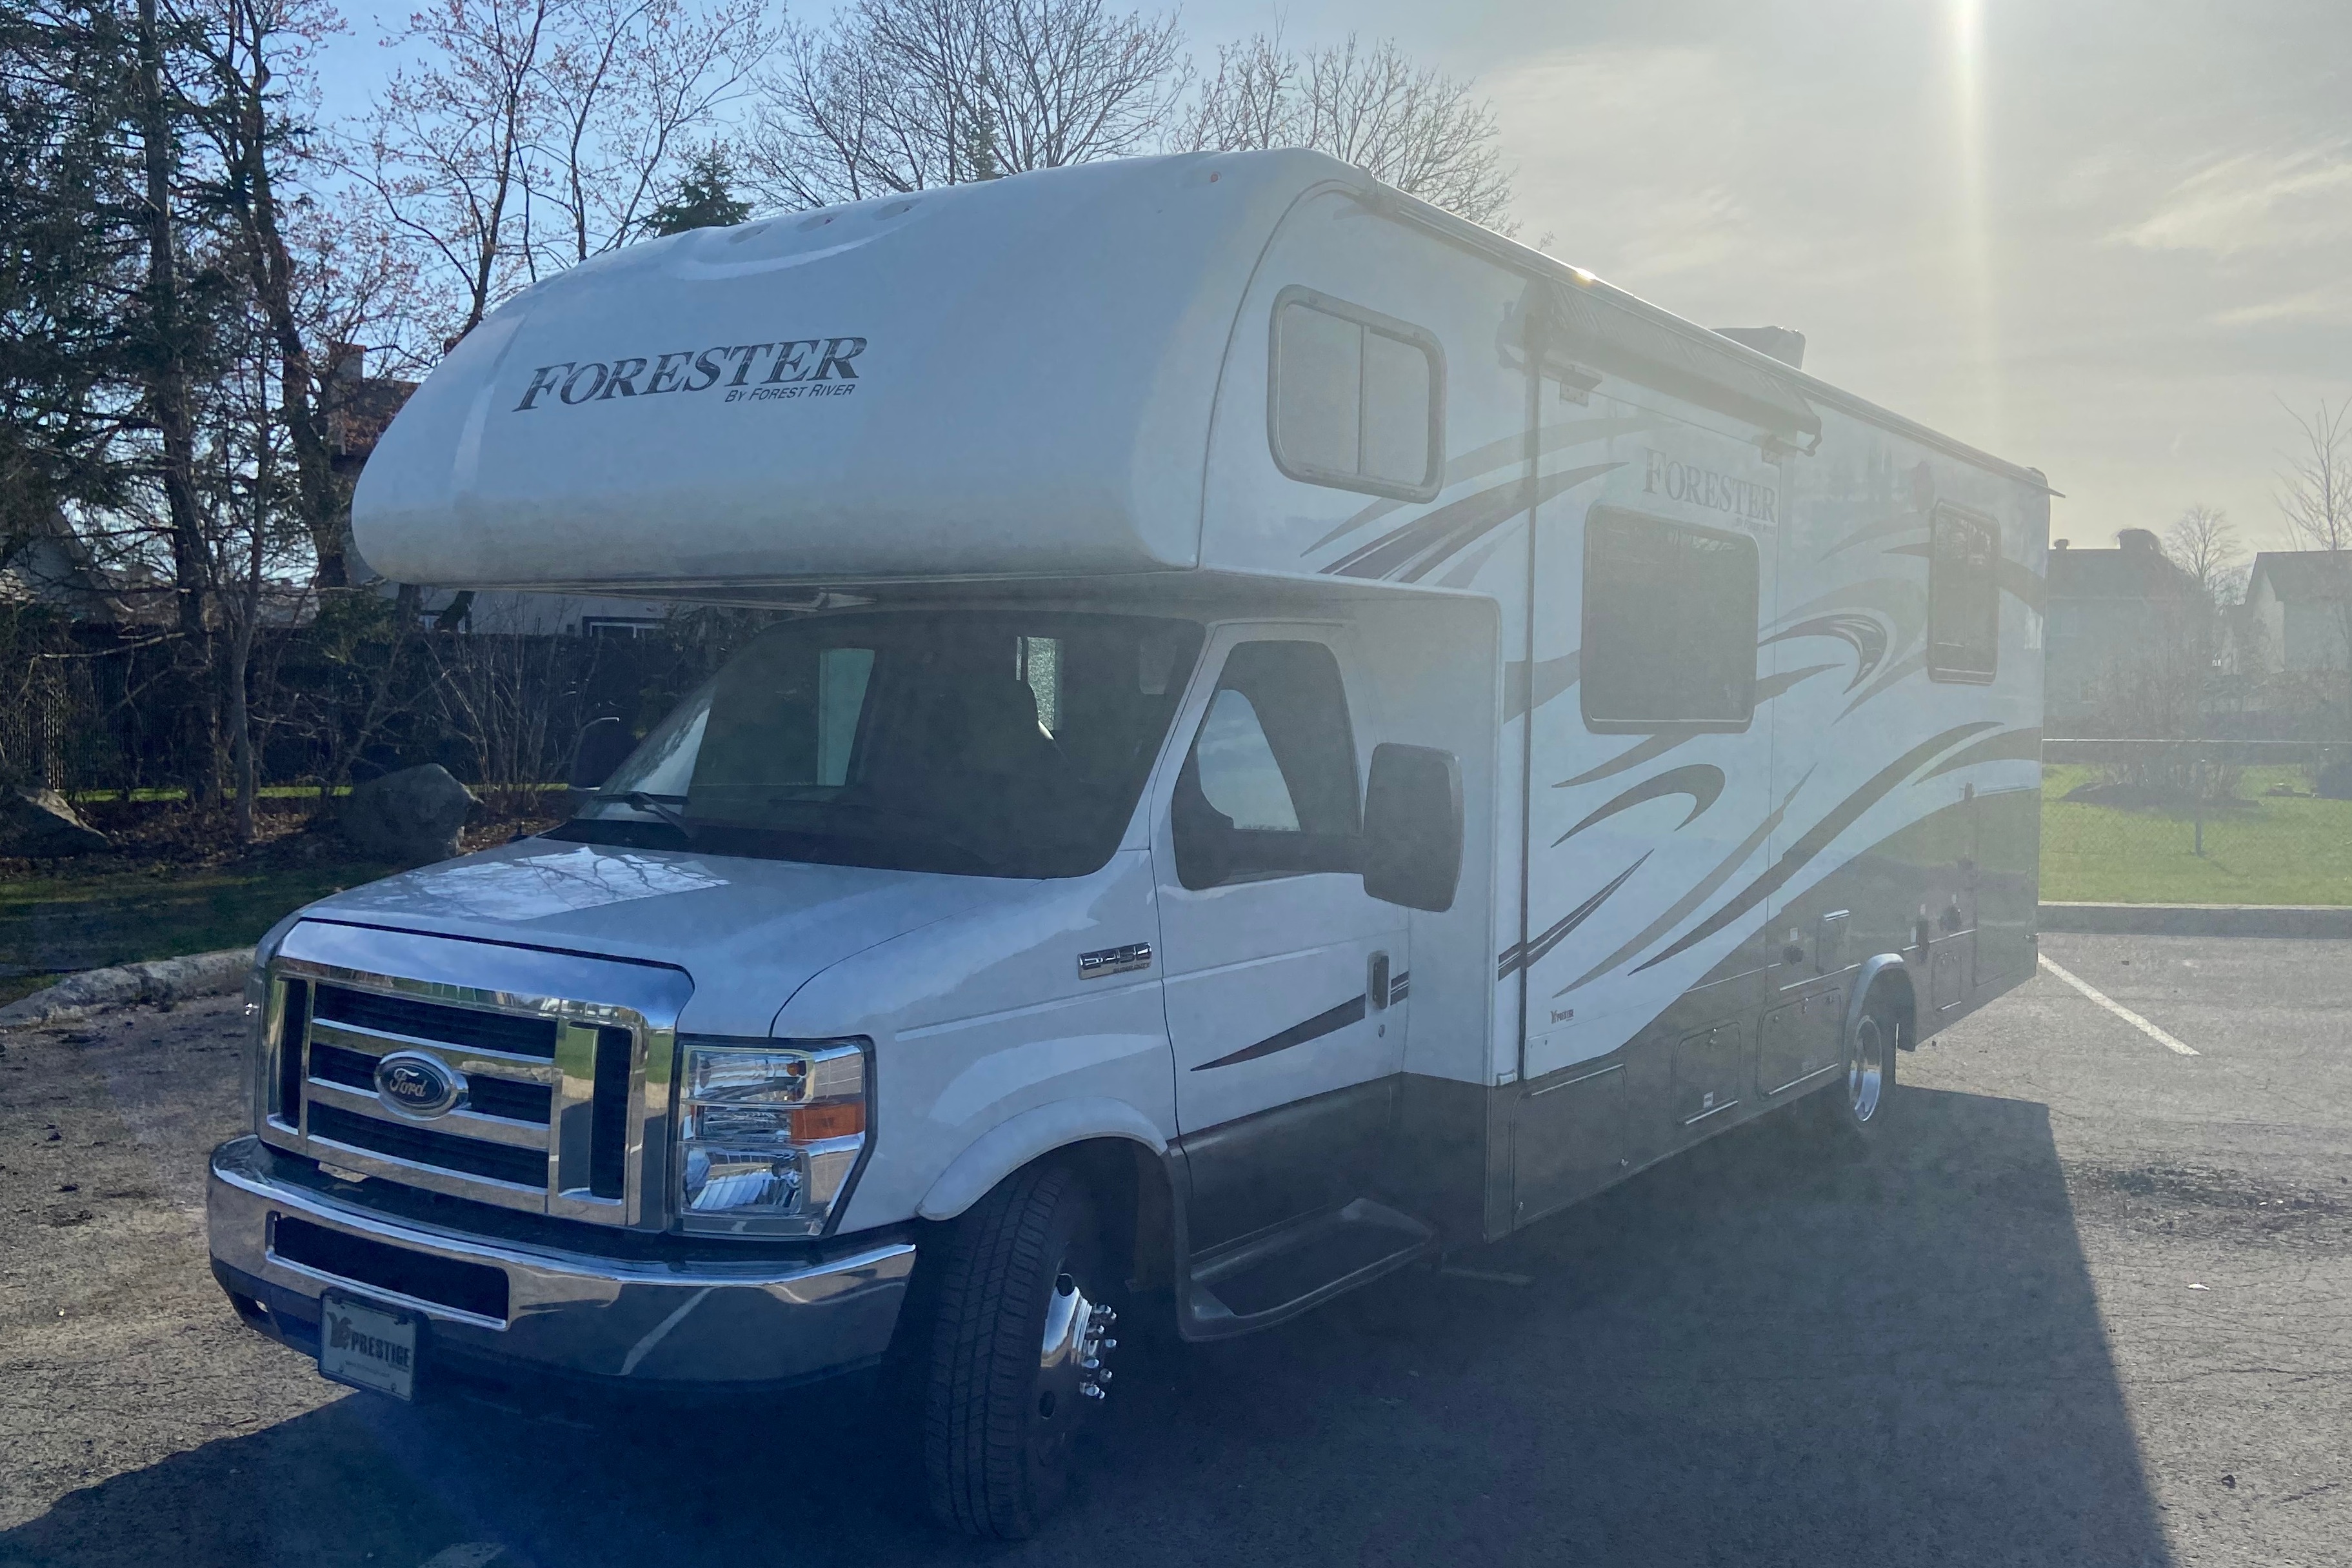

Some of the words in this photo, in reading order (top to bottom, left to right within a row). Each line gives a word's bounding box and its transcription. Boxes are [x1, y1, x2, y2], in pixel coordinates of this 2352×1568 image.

[512, 337, 868, 413] FORESTER
[724, 390, 747, 402] BY
[748, 387, 808, 401] FOREST
[808, 384, 856, 397] RIVER
[1642, 447, 1776, 523] FORESTER
[390, 1067, 427, 1097] Ford
[351, 1331, 411, 1368] PRESTIGE
